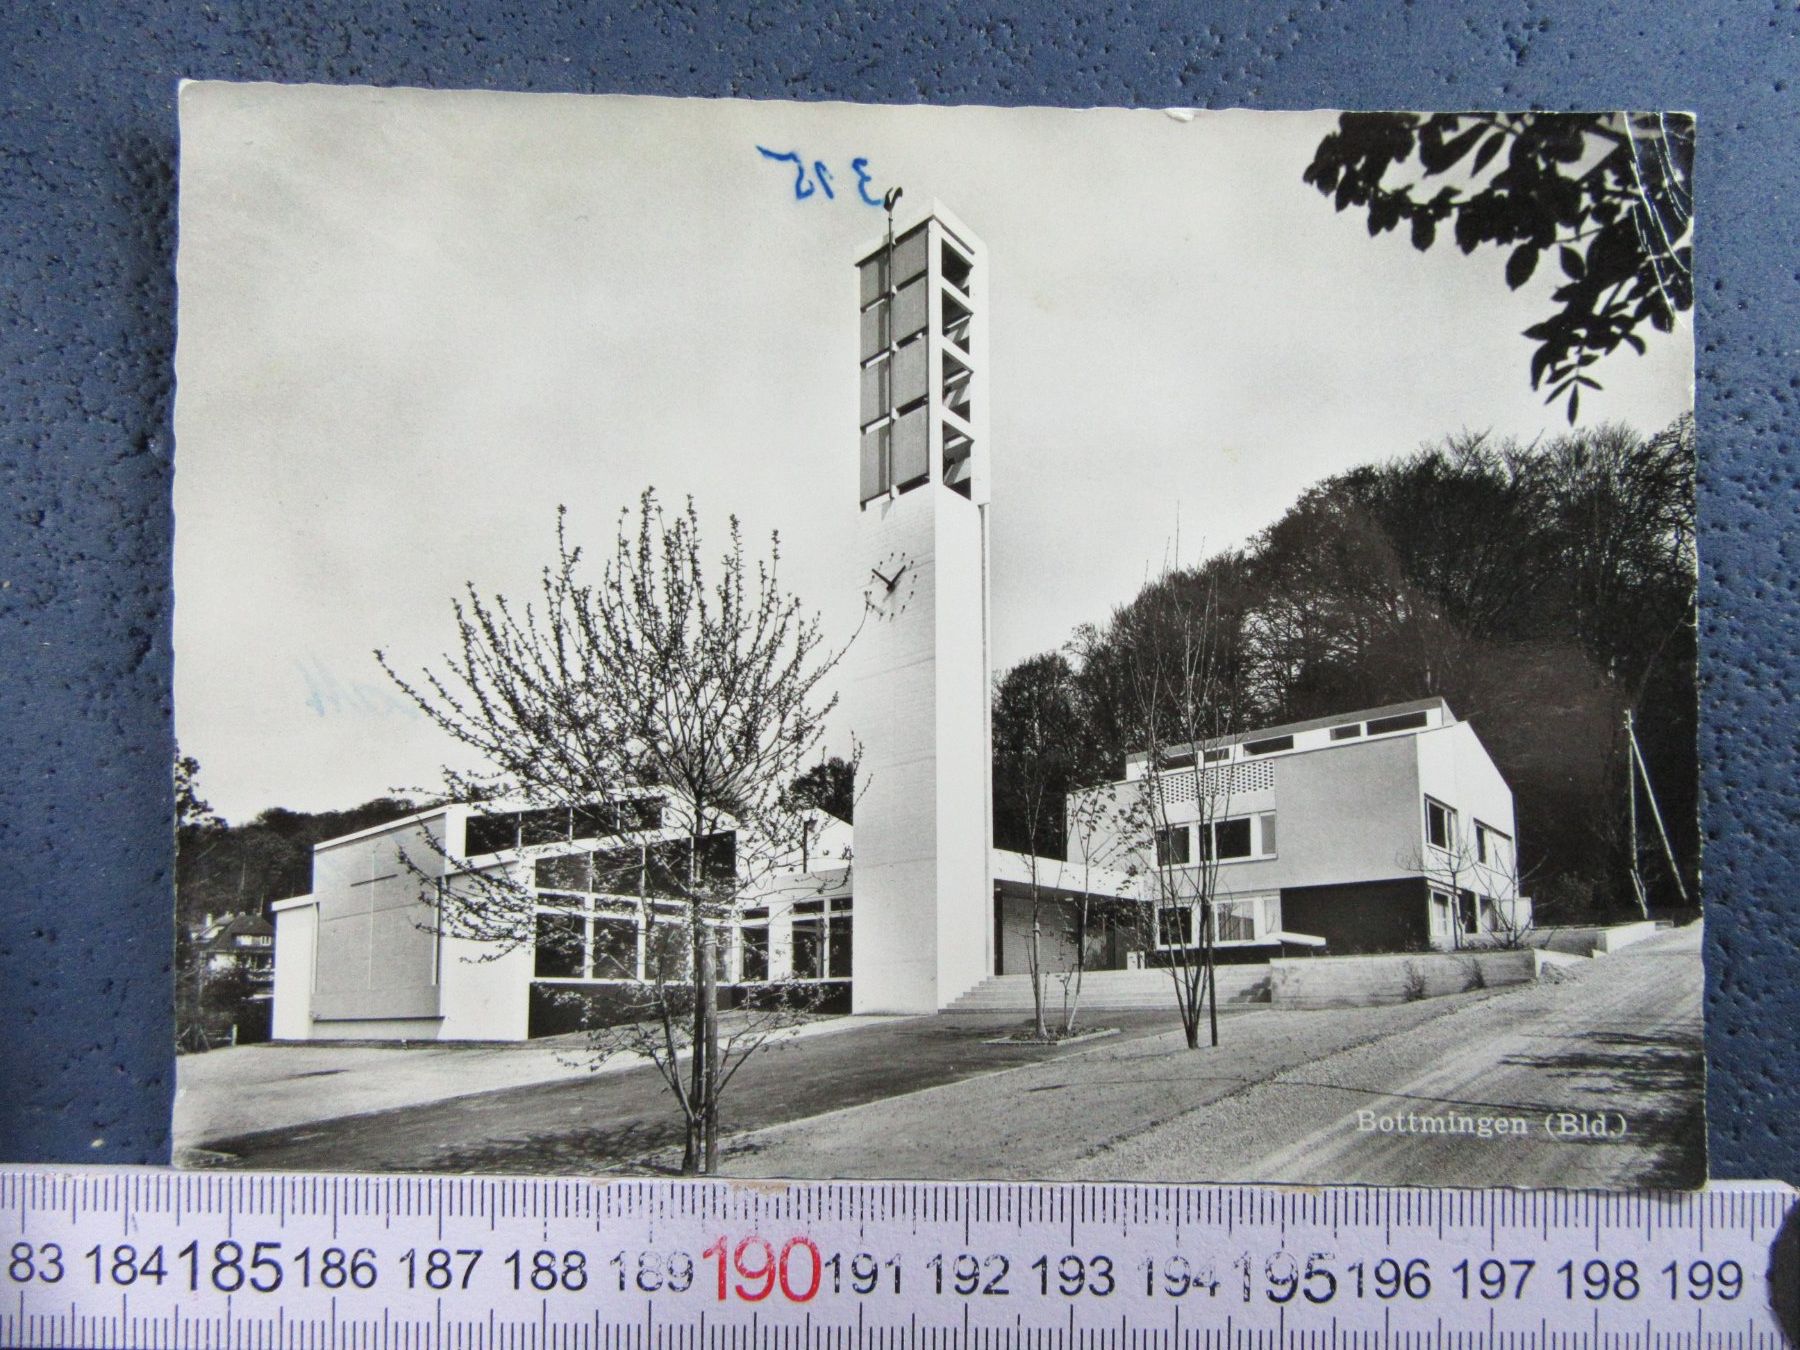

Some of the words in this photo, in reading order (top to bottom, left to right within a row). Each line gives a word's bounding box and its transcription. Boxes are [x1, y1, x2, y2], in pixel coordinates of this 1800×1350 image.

[1357, 1109, 1529, 1138] Bottmingen
[1545, 1112, 1627, 1141] (Bld.)
[8, 1241, 65, 1284] 83
[85, 1243, 168, 1287] 184
[178, 1239, 284, 1294] 185
[294, 1246, 378, 1289] 186
[399, 1247, 483, 1291] 187
[504, 1248, 588, 1292] 188
[609, 1250, 694, 1293] 189
[702, 1235, 823, 1304] 190
[825, 1252, 911, 1295] 191
[925, 1254, 1010, 1296] 192
[1031, 1254, 1115, 1298] 193
[1137, 1255, 1222, 1298] 194
[1232, 1250, 1338, 1305] 195
[1346, 1257, 1432, 1301] 196
[1452, 1258, 1537, 1301] 197
[1556, 1258, 1641, 1302] 198
[1662, 1259, 1744, 1303] 199
